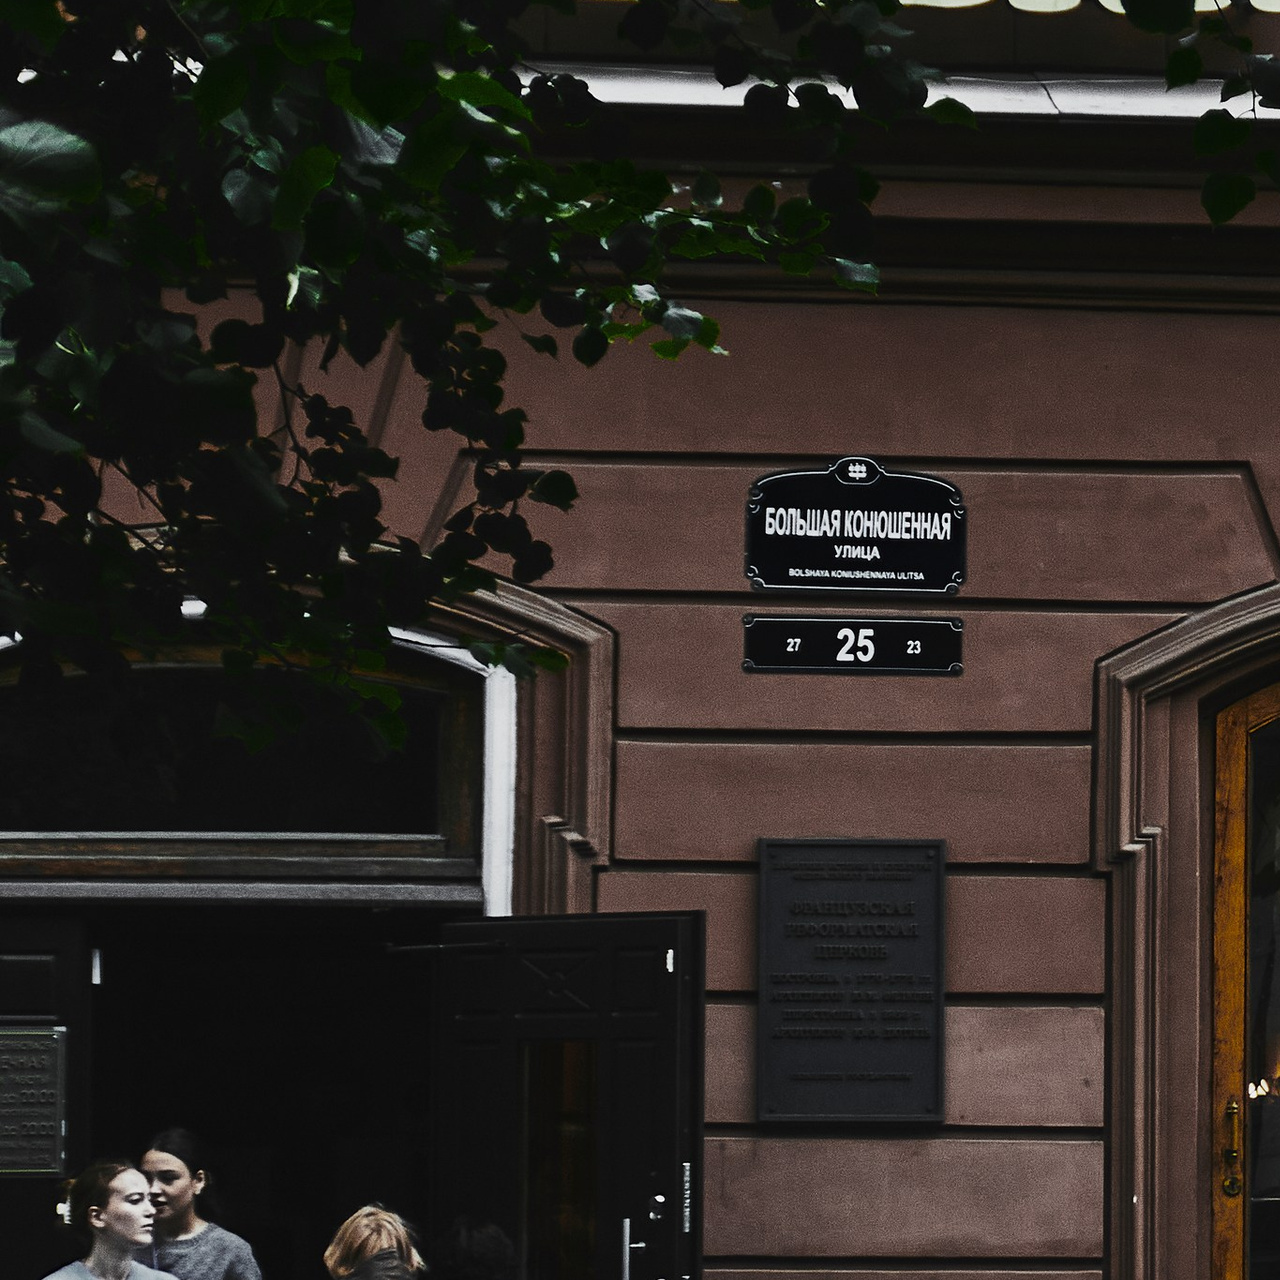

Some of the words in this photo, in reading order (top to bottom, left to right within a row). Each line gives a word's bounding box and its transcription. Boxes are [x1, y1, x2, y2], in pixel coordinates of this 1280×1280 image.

[765, 507, 841, 538] БОЛЬШАЯ
[844, 510, 952, 540] КОНЮШЕННАЯ
[834, 545, 881, 561] УЛИЦА
[788, 568, 830, 578] BOLSHAYA
[897, 571, 925, 580] ULITSA
[786, 638, 801, 652] 27
[836, 628, 875, 662] 25
[907, 640, 922, 654] 23
